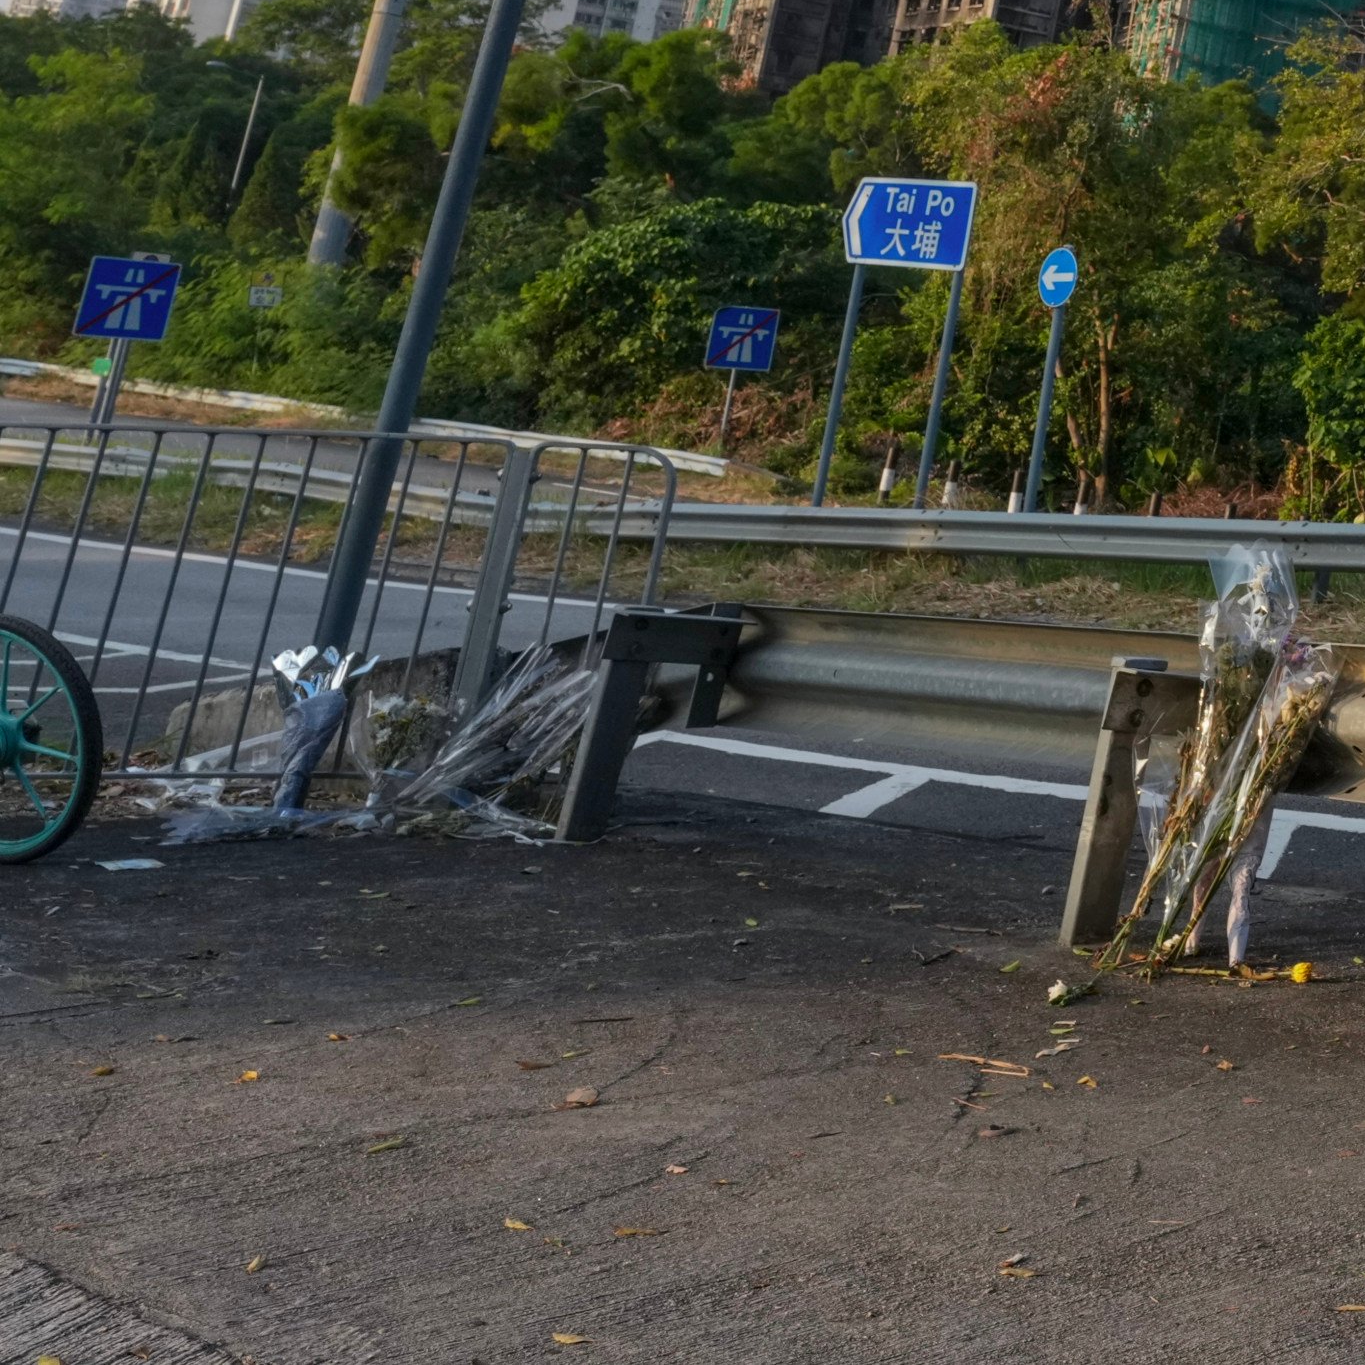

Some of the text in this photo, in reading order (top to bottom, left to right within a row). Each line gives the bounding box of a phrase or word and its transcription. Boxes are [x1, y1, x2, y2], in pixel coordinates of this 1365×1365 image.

[886, 187, 955, 217] Tai Po
[880, 218, 942, 259] 大埔
